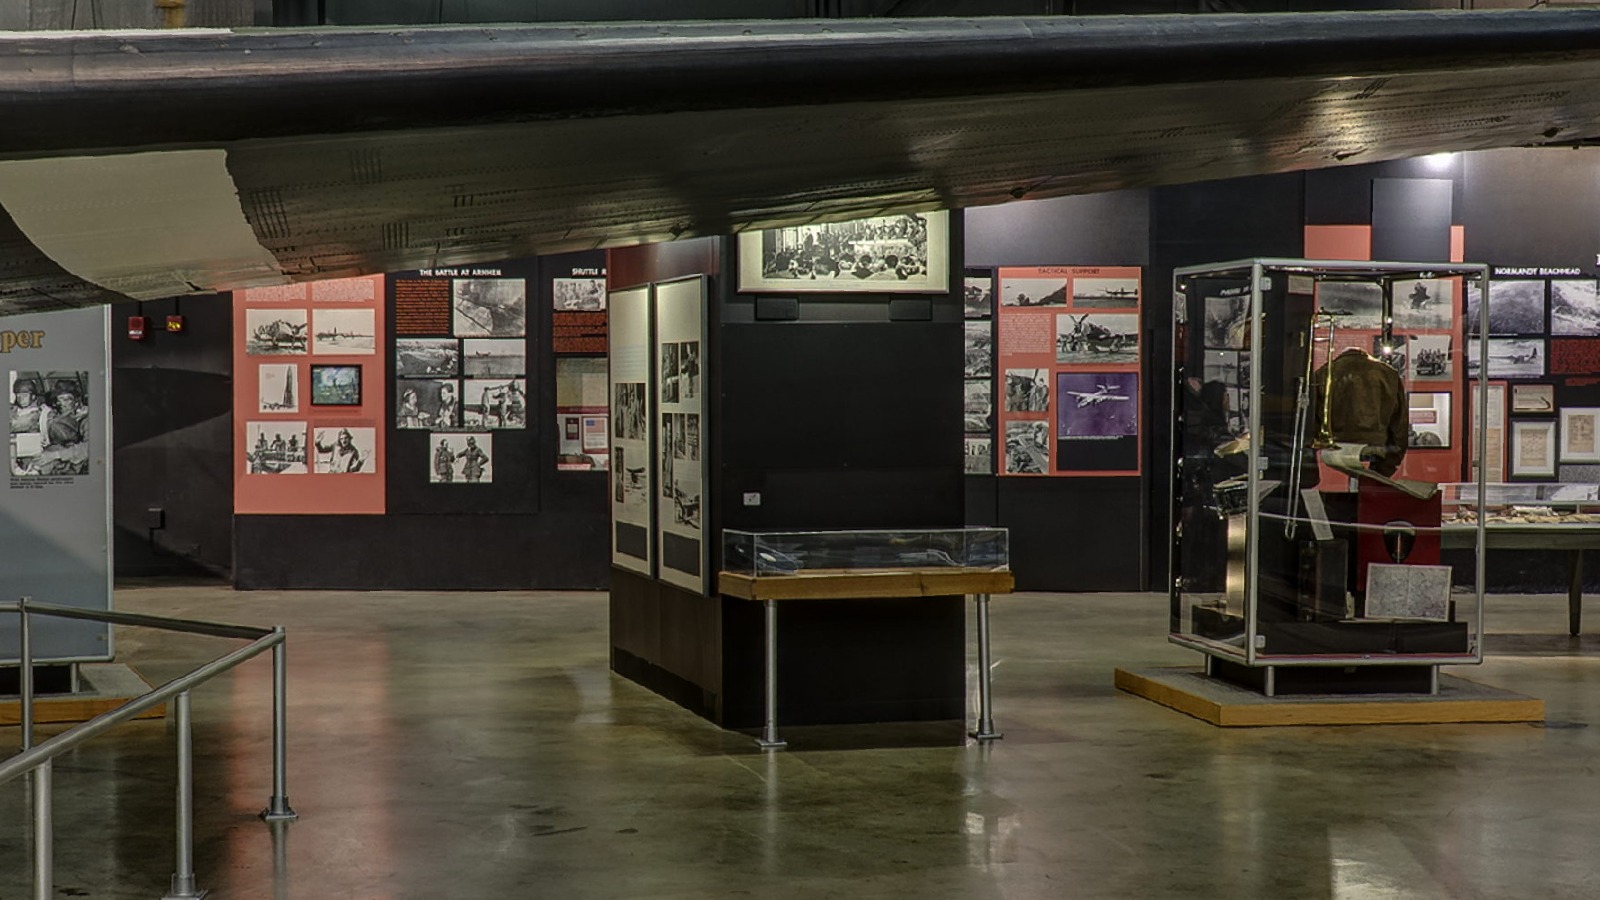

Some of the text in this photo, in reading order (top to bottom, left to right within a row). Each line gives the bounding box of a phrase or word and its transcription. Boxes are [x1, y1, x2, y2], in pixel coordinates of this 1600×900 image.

[572, 267, 598, 275] SHUTTLE
[1494, 267, 1580, 275] NORMANDY BEACHHEAD
